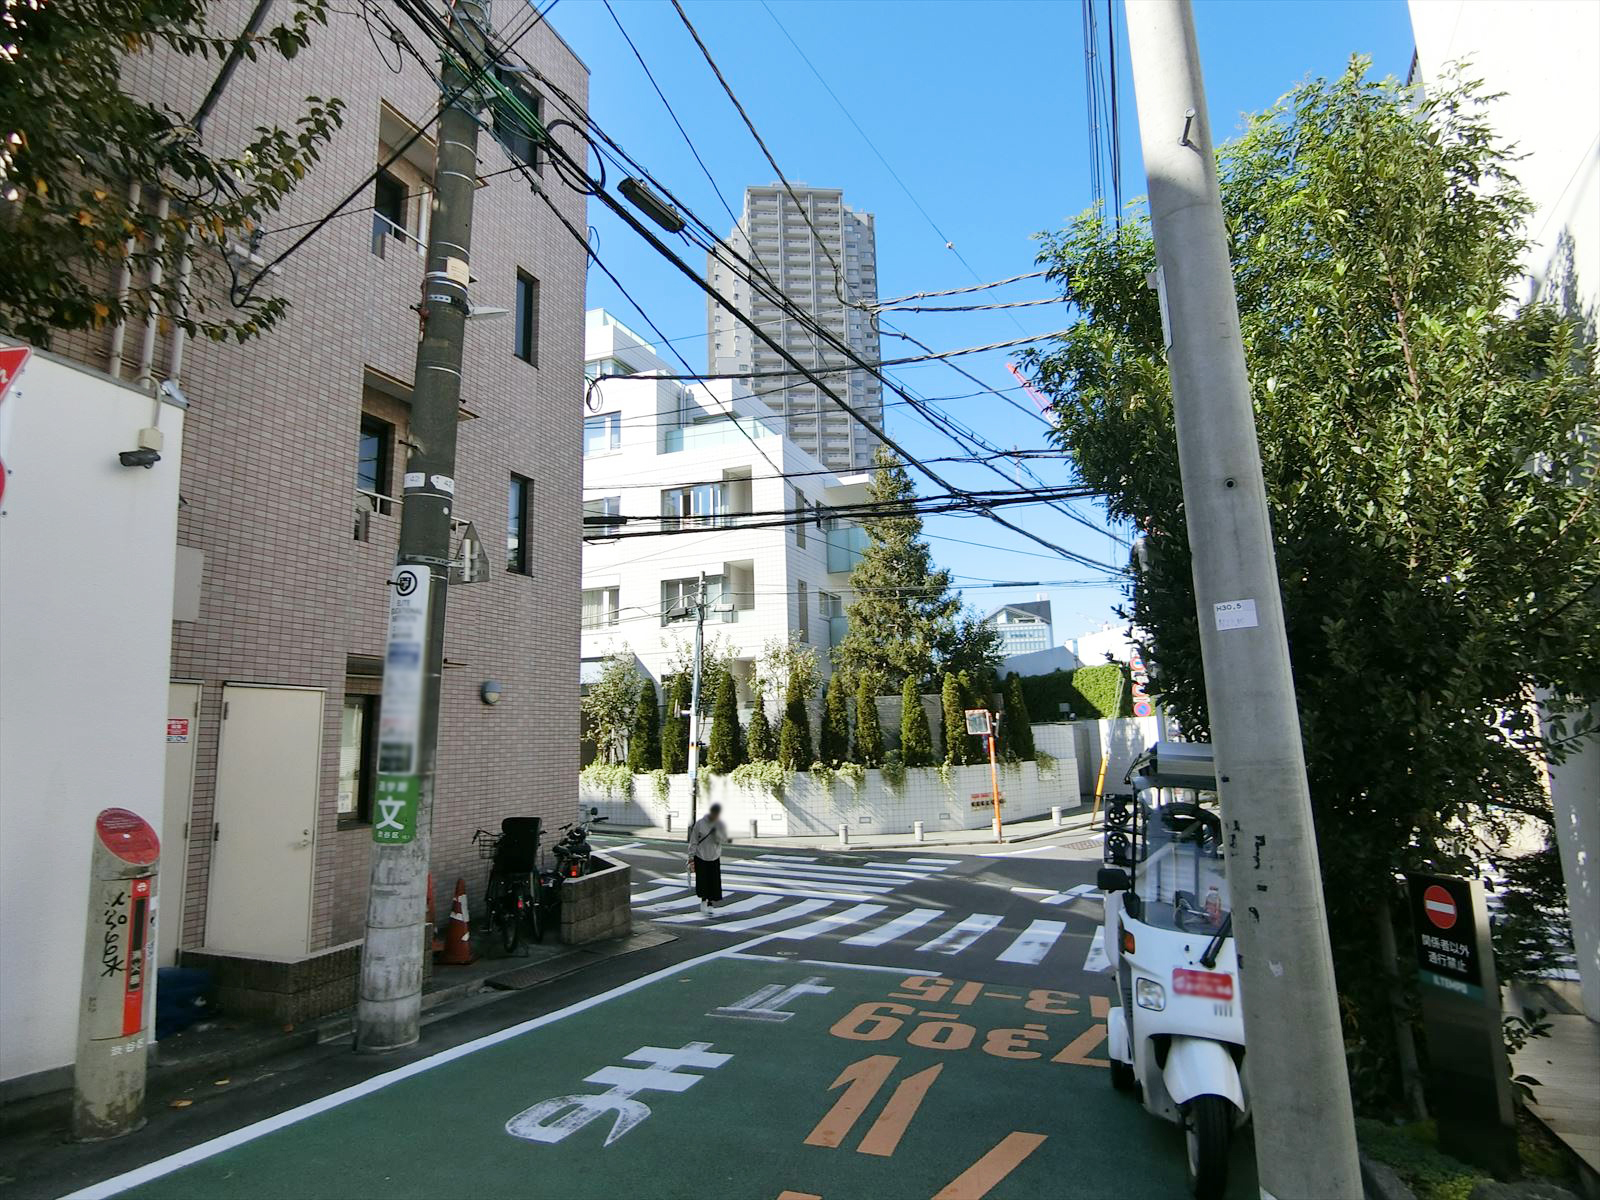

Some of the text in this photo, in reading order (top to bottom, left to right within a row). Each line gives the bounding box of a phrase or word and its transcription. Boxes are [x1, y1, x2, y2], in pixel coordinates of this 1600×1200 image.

[1216, 602, 1242, 613] H30.5
[1421, 935, 1469, 957] 関係者以外
[1427, 950, 1468, 973] 通行禁止
